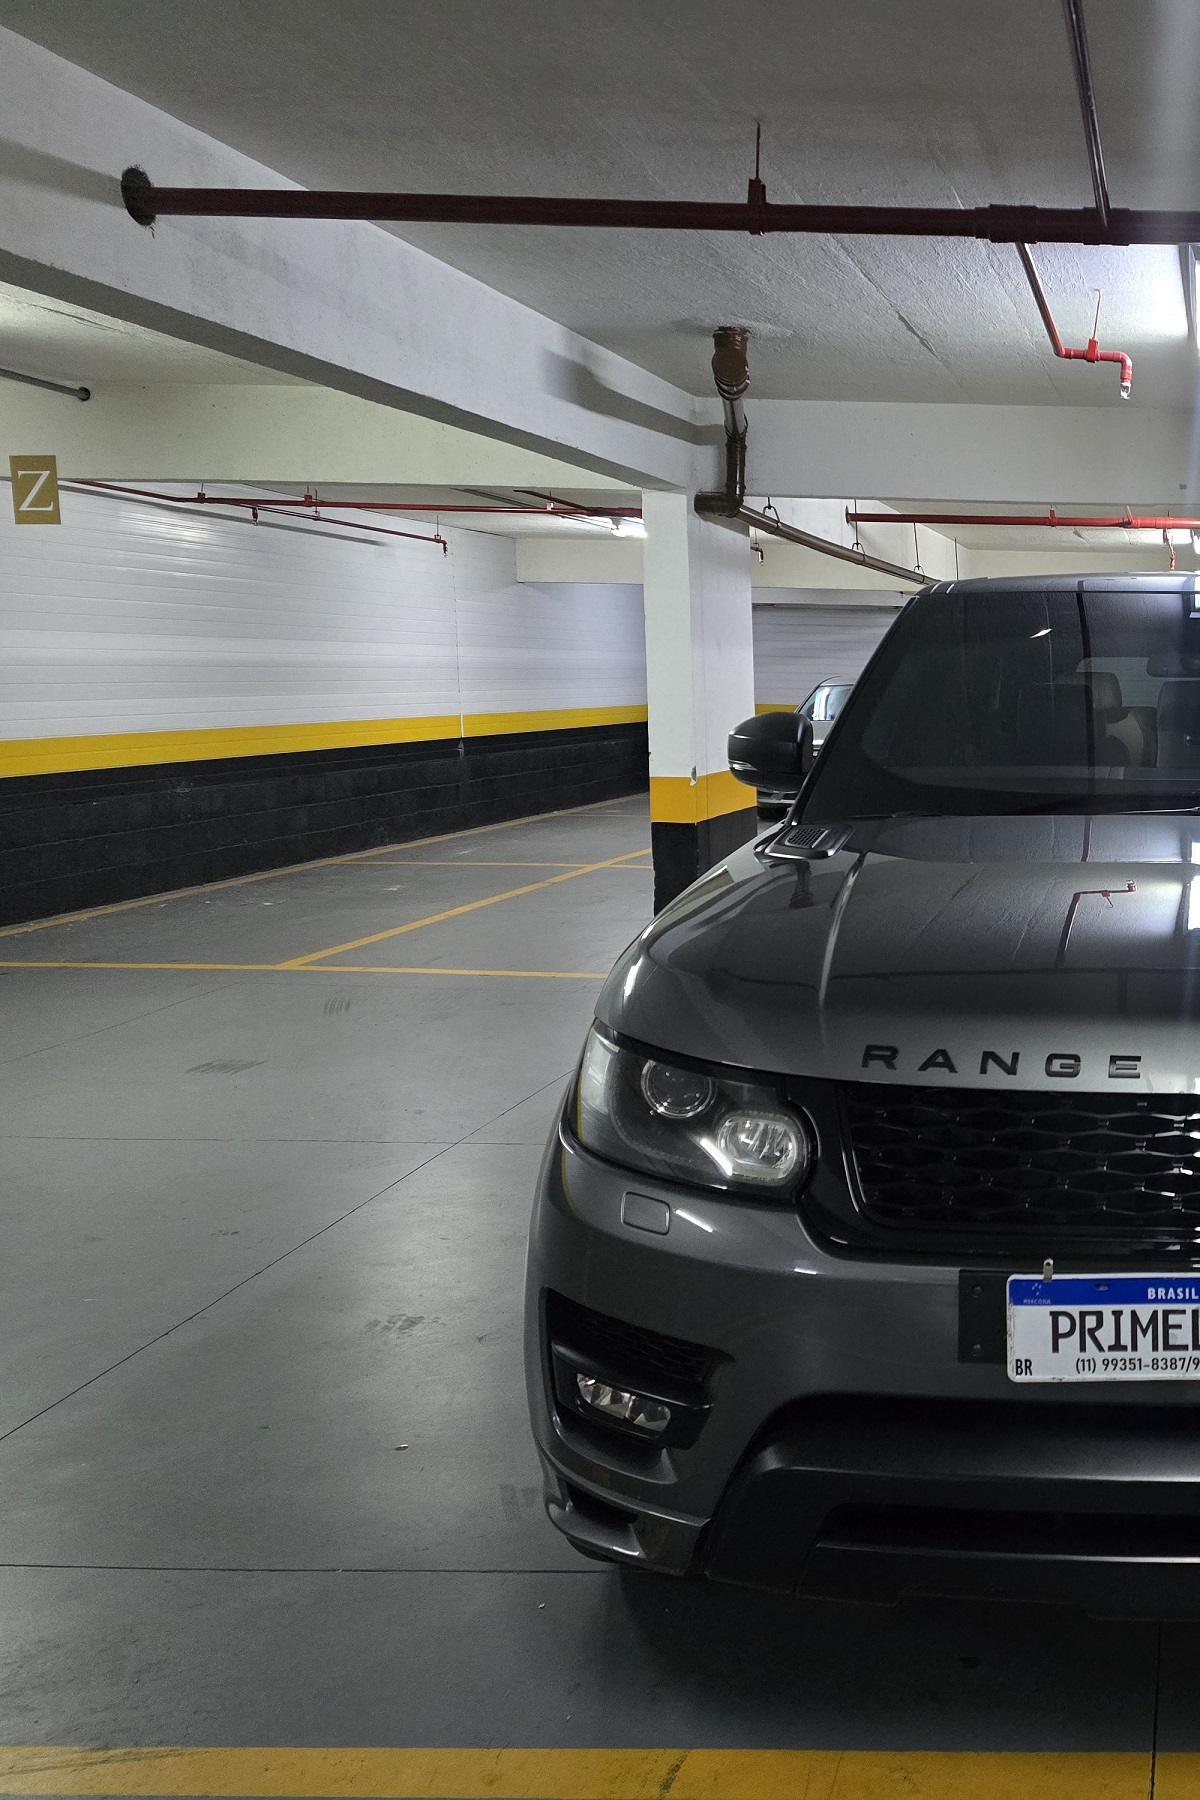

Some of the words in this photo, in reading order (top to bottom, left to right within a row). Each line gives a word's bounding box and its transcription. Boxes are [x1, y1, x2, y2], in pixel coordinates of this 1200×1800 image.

[18, 470, 54, 511] Z
[861, 1044, 1142, 1079] RANGE
[1147, 1287, 1200, 1300] BRASIL
[1015, 1358, 1033, 1377] BR
[1075, 1358, 1097, 1374] (11)
